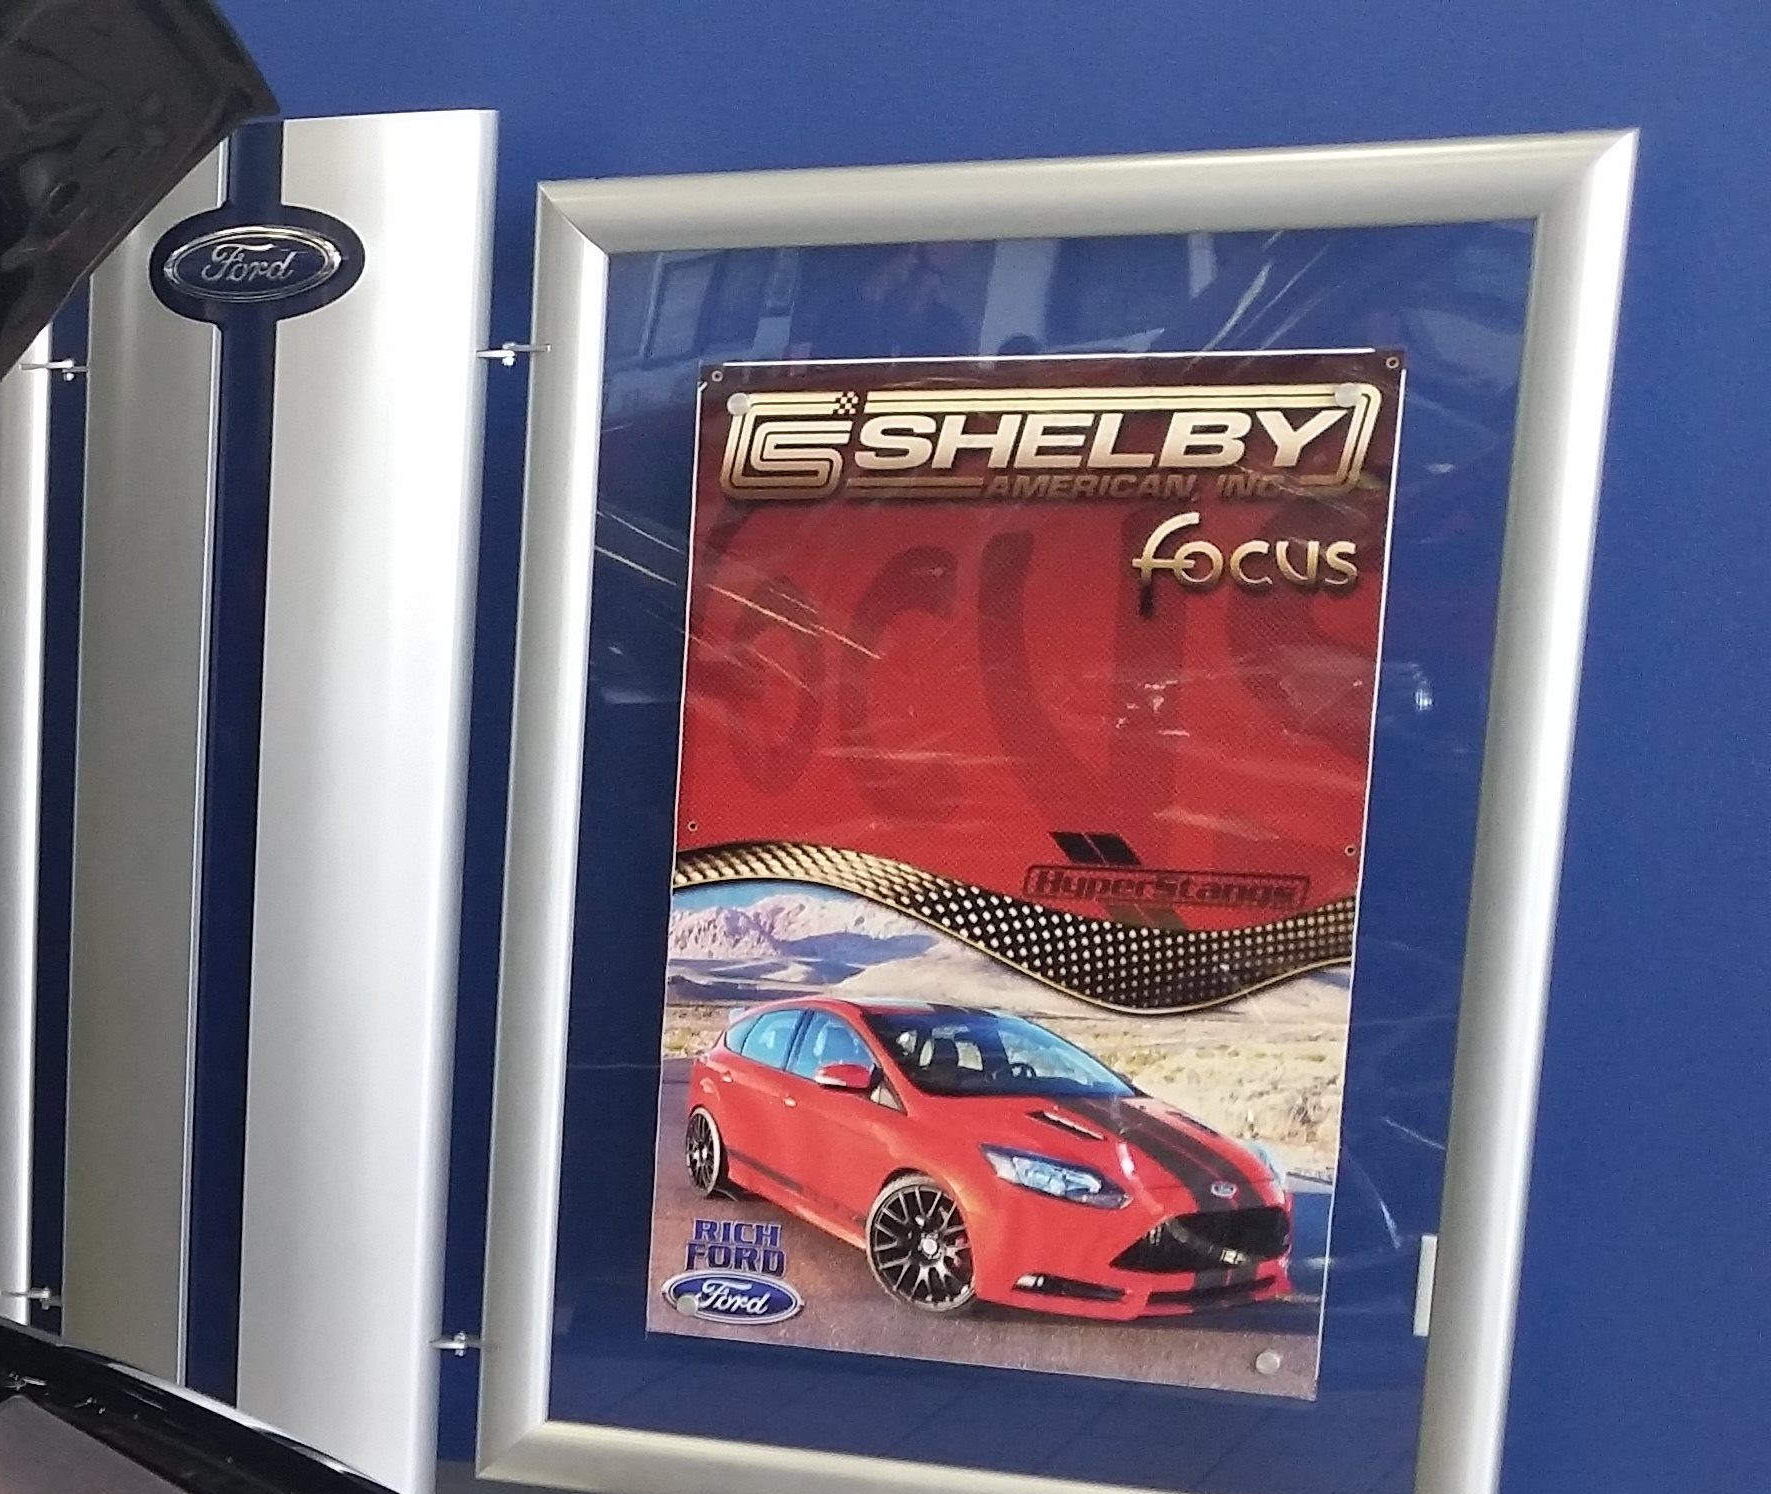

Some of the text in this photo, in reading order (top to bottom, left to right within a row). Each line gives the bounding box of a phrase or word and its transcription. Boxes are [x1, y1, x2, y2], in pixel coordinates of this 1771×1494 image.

[200, 242, 298, 284] Ford
[855, 411, 1350, 470] SHELBY
[1132, 512, 1359, 588] focus
[693, 1218, 781, 1249] RICH
[685, 1241, 787, 1278] FORD
